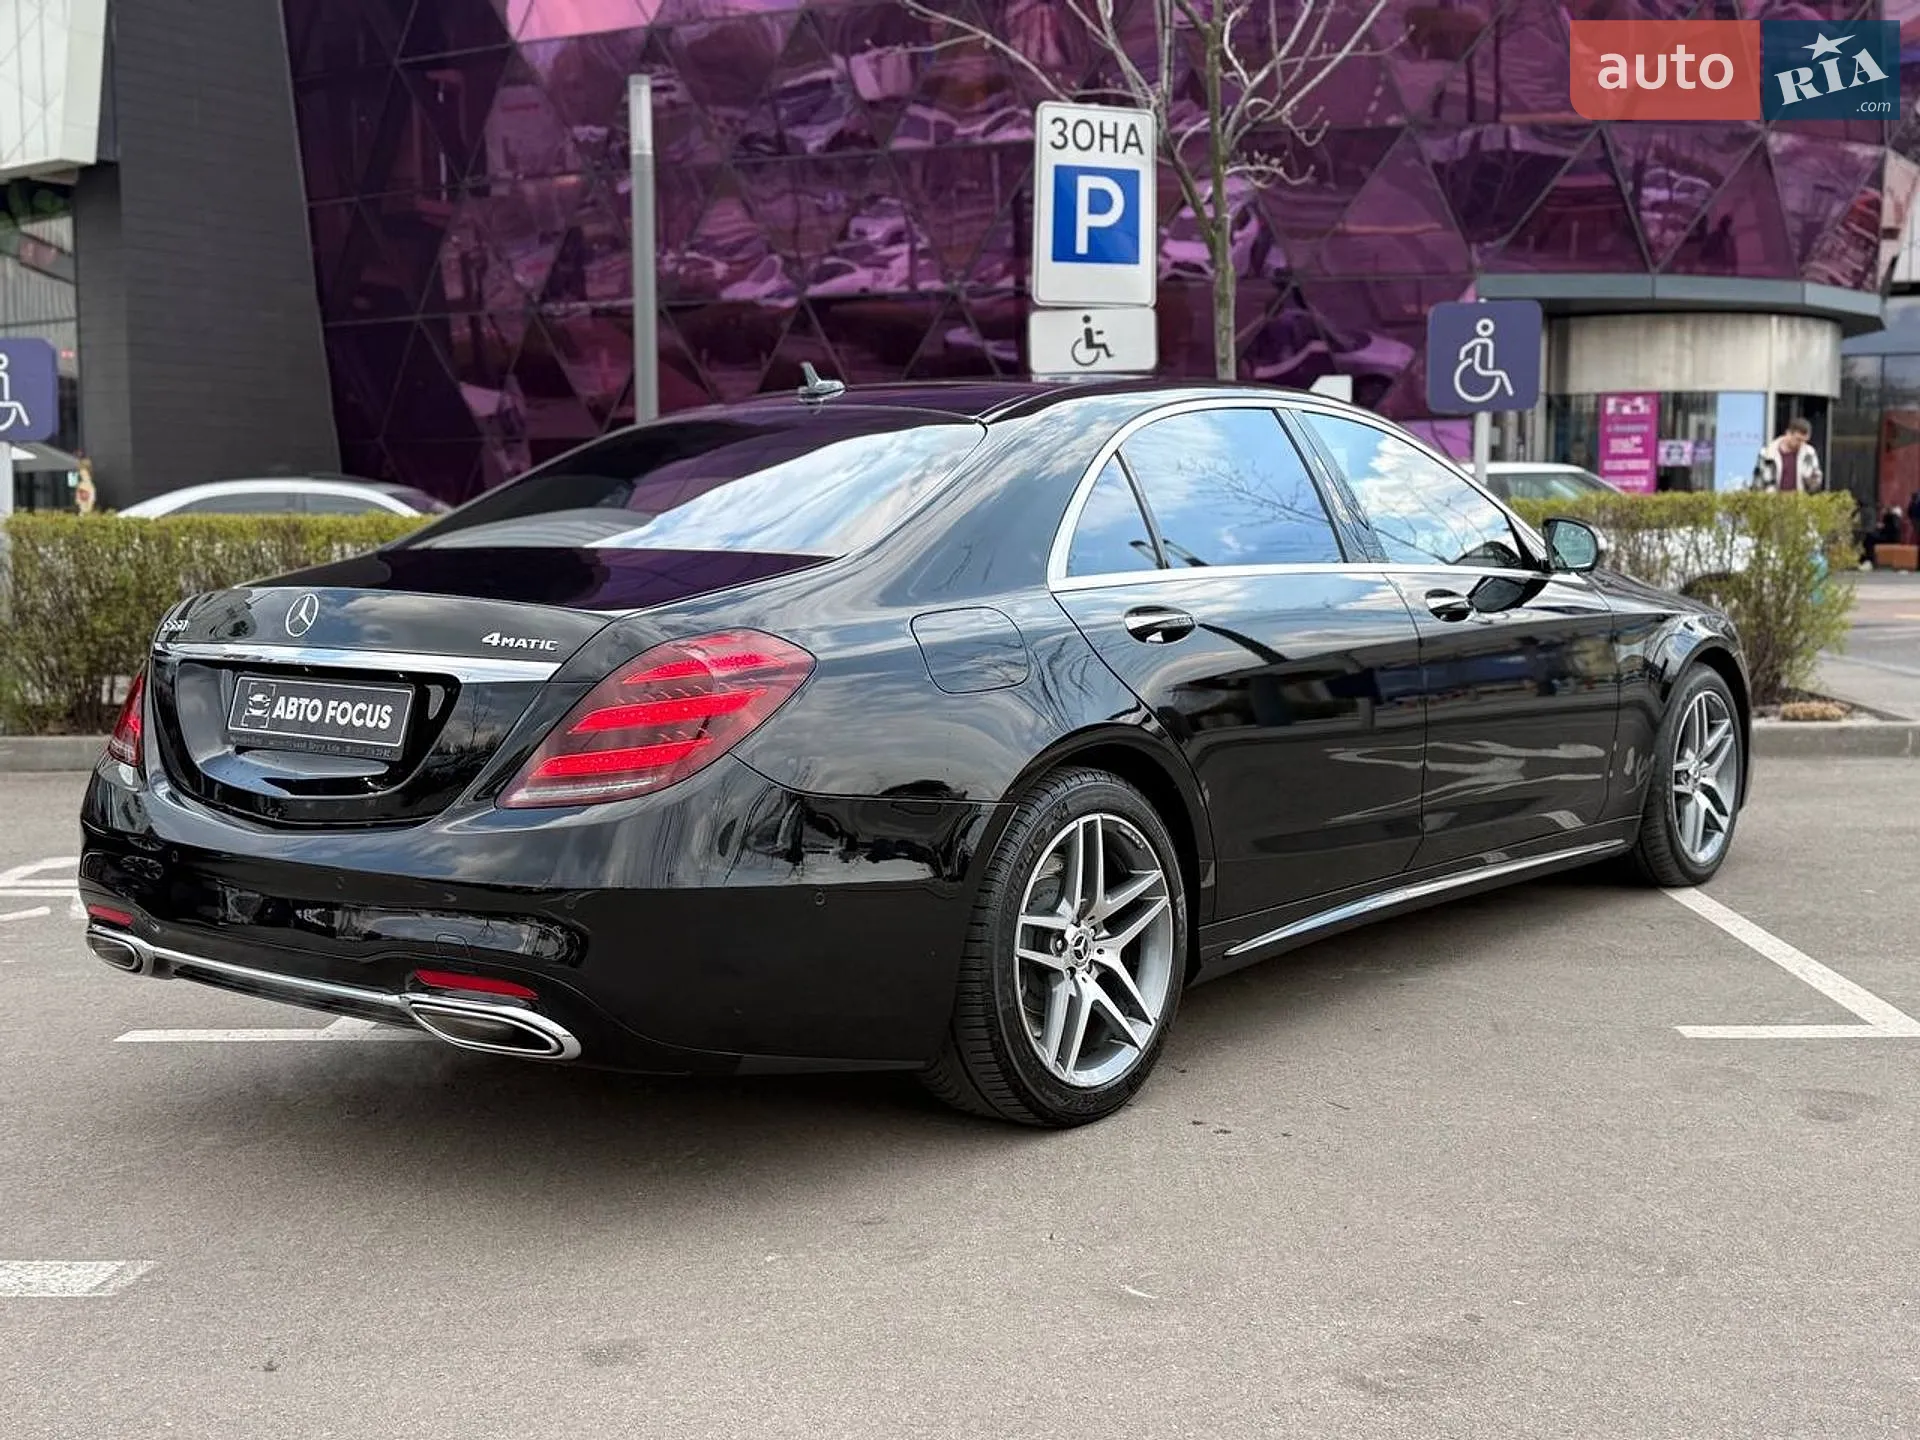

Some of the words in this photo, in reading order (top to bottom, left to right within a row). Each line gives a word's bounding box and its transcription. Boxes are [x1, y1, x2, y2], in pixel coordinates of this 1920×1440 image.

[1050, 117, 1144, 155] ЗОНА
[1075, 175, 1125, 255] P
[482, 632, 560, 651] 4MATIC
[272, 696, 322, 723] АВТО
[325, 700, 392, 729] FOCUS
